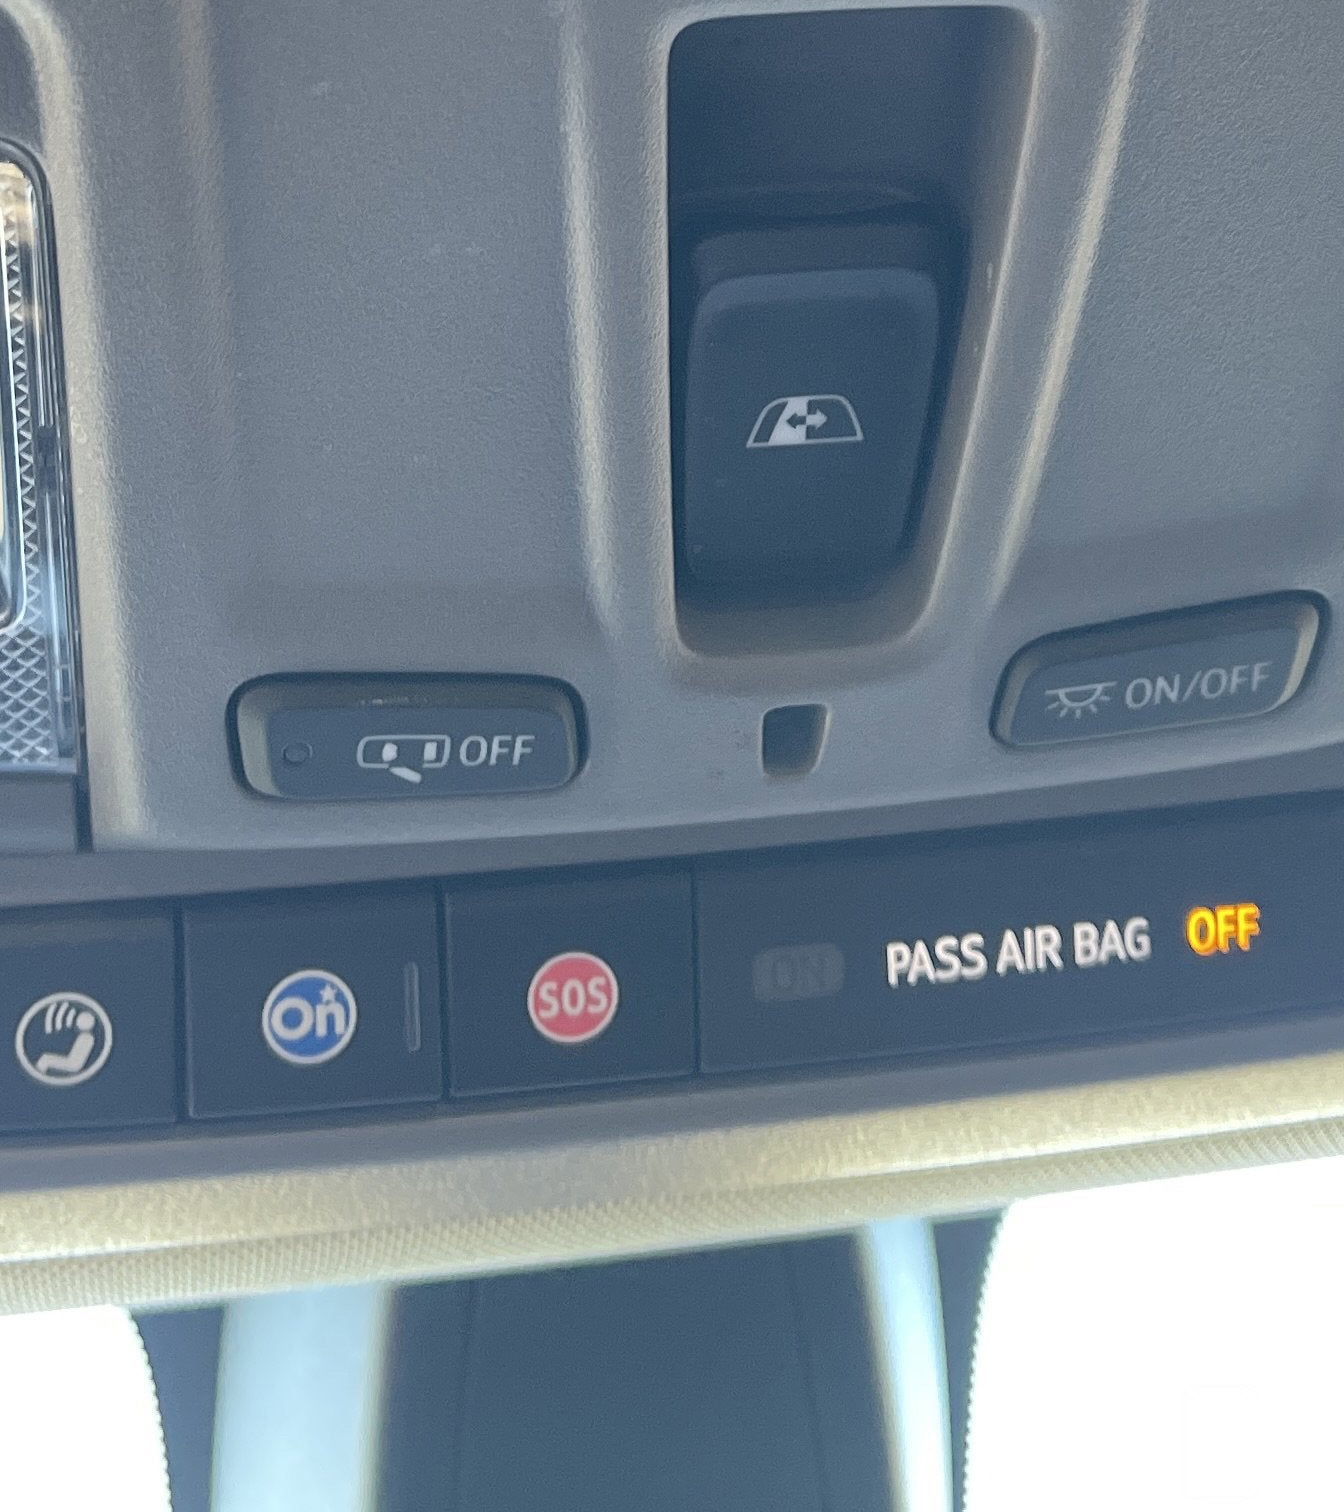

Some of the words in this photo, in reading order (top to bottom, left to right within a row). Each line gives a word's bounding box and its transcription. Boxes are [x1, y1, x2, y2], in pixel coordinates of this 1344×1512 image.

[1124, 662, 1274, 709] ON/OFF
[458, 734, 536, 767] OFF
[885, 933, 988, 987] PASS
[995, 925, 1062, 976] AIR
[1071, 916, 1151, 968] BAG
[1184, 902, 1261, 957] OFF
[537, 975, 609, 1020] SOS
